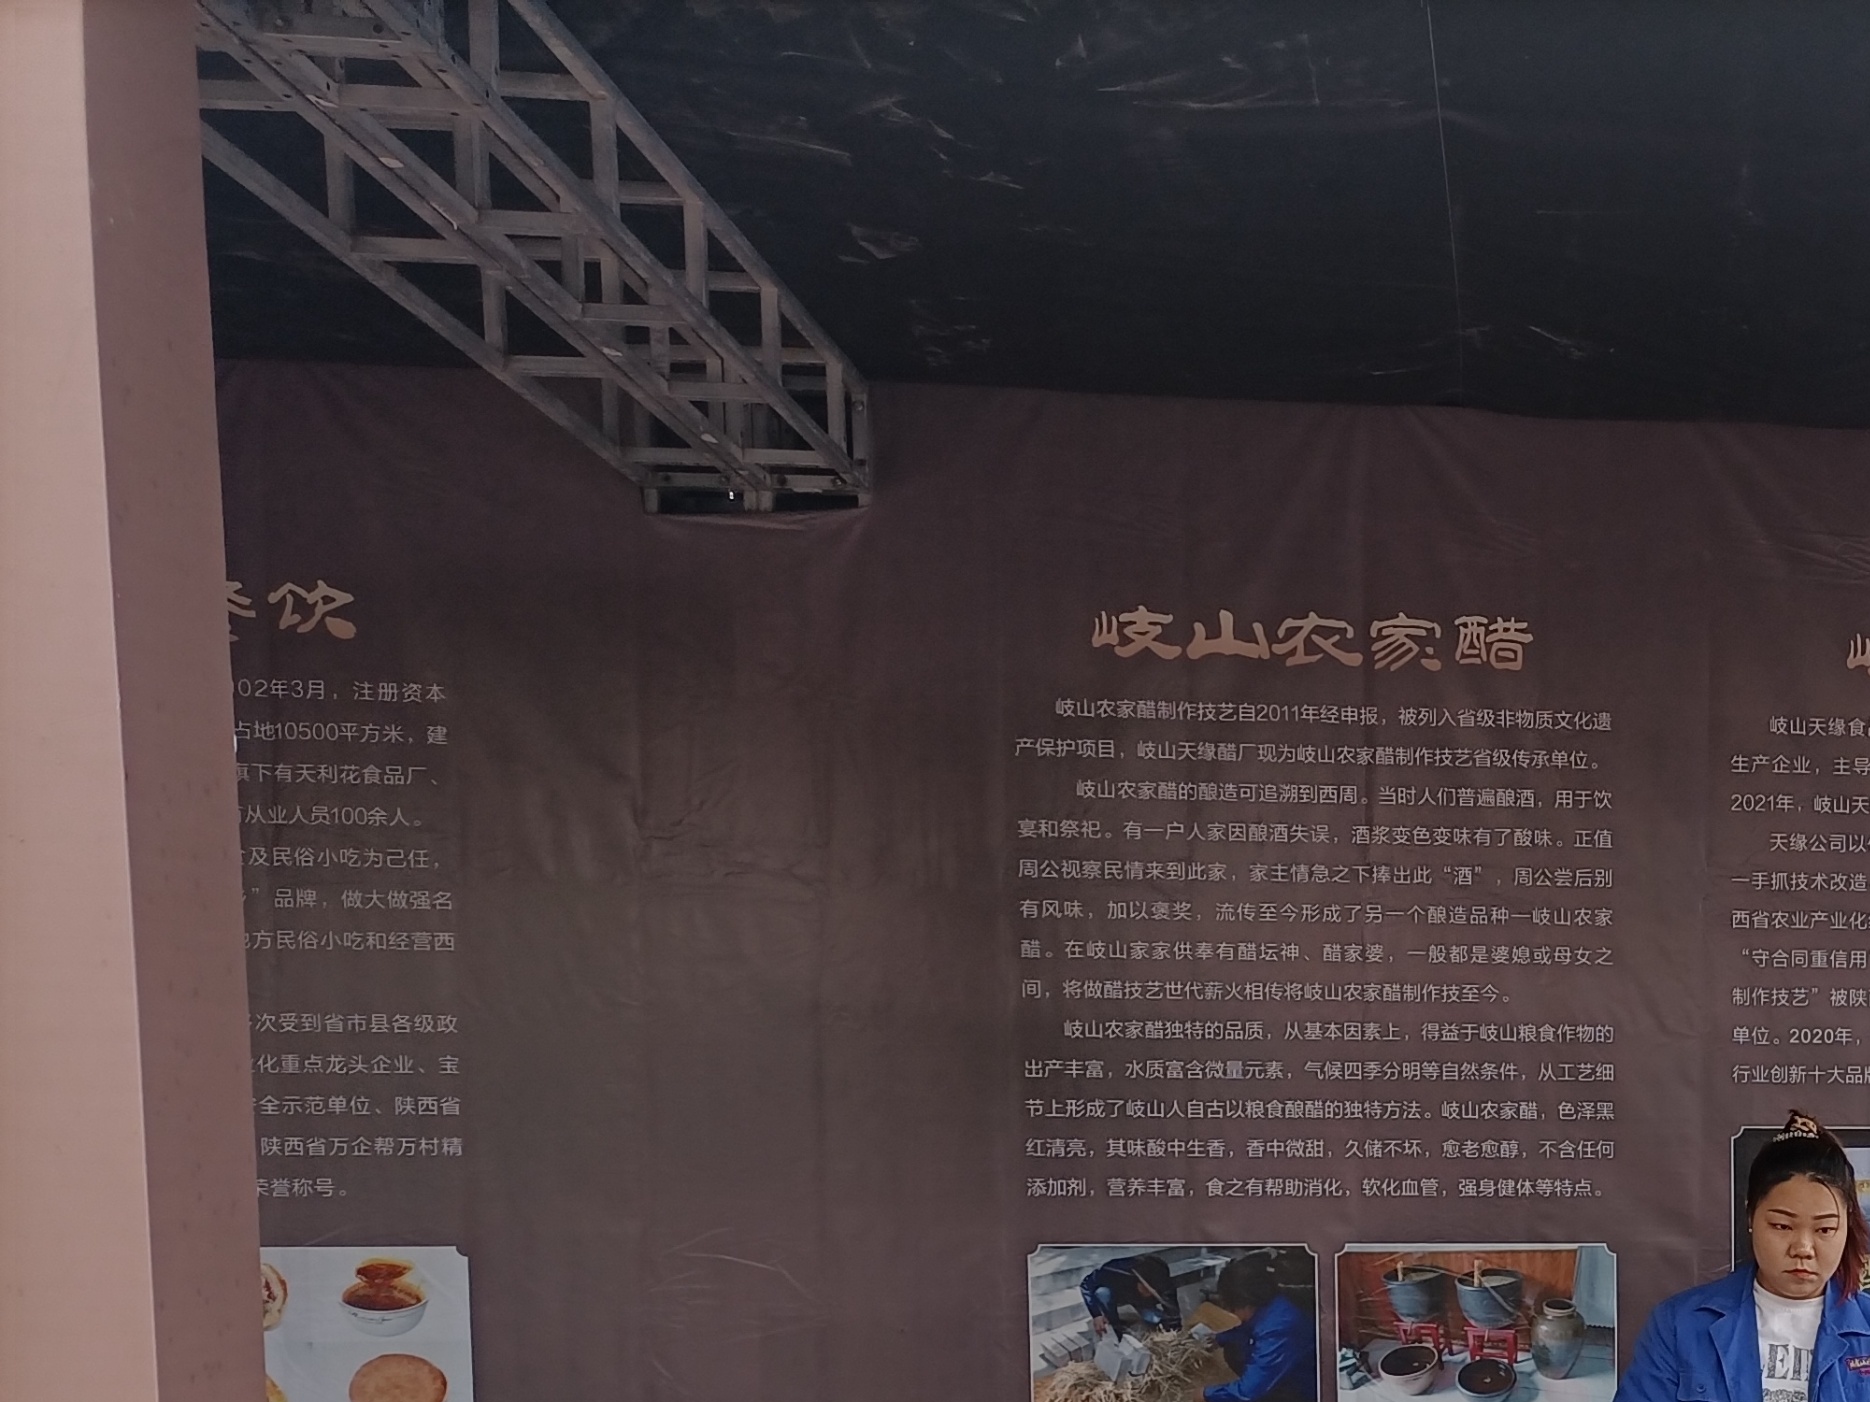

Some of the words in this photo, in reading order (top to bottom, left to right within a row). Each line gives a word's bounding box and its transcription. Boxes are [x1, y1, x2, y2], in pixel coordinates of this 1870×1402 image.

[1091, 605, 1534, 672] 岐山农家醋
[1055, 698, 1612, 731] 岐山农家醋制作技艺自2011年经申报，被列入省级非物质文化遗
[1014, 738, 1601, 770] 产保护项目，岐山天缘醋厂现为岐山农家醋制作技艺省级传承单位。
[1076, 780, 1613, 810] 岐山农家醋的酿造可追溯到西周。当时人们普遍酿酒，用于饮
[1017, 818, 1613, 849] 宴和祭祀。有一户人家因酿酒失误，酒浆变色变味有了酸味。正值
[250, 1013, 458, 1034] 次受到省市县各级政
[1063, 1019, 1614, 1043] 岐山农家醋独特的品质，从基本因素上，得益于岐山粮食作物的
[251, 1054, 460, 1075] 化重点龙头企业、宝
[253, 1095, 461, 1117] 全示范单位、陕西省
